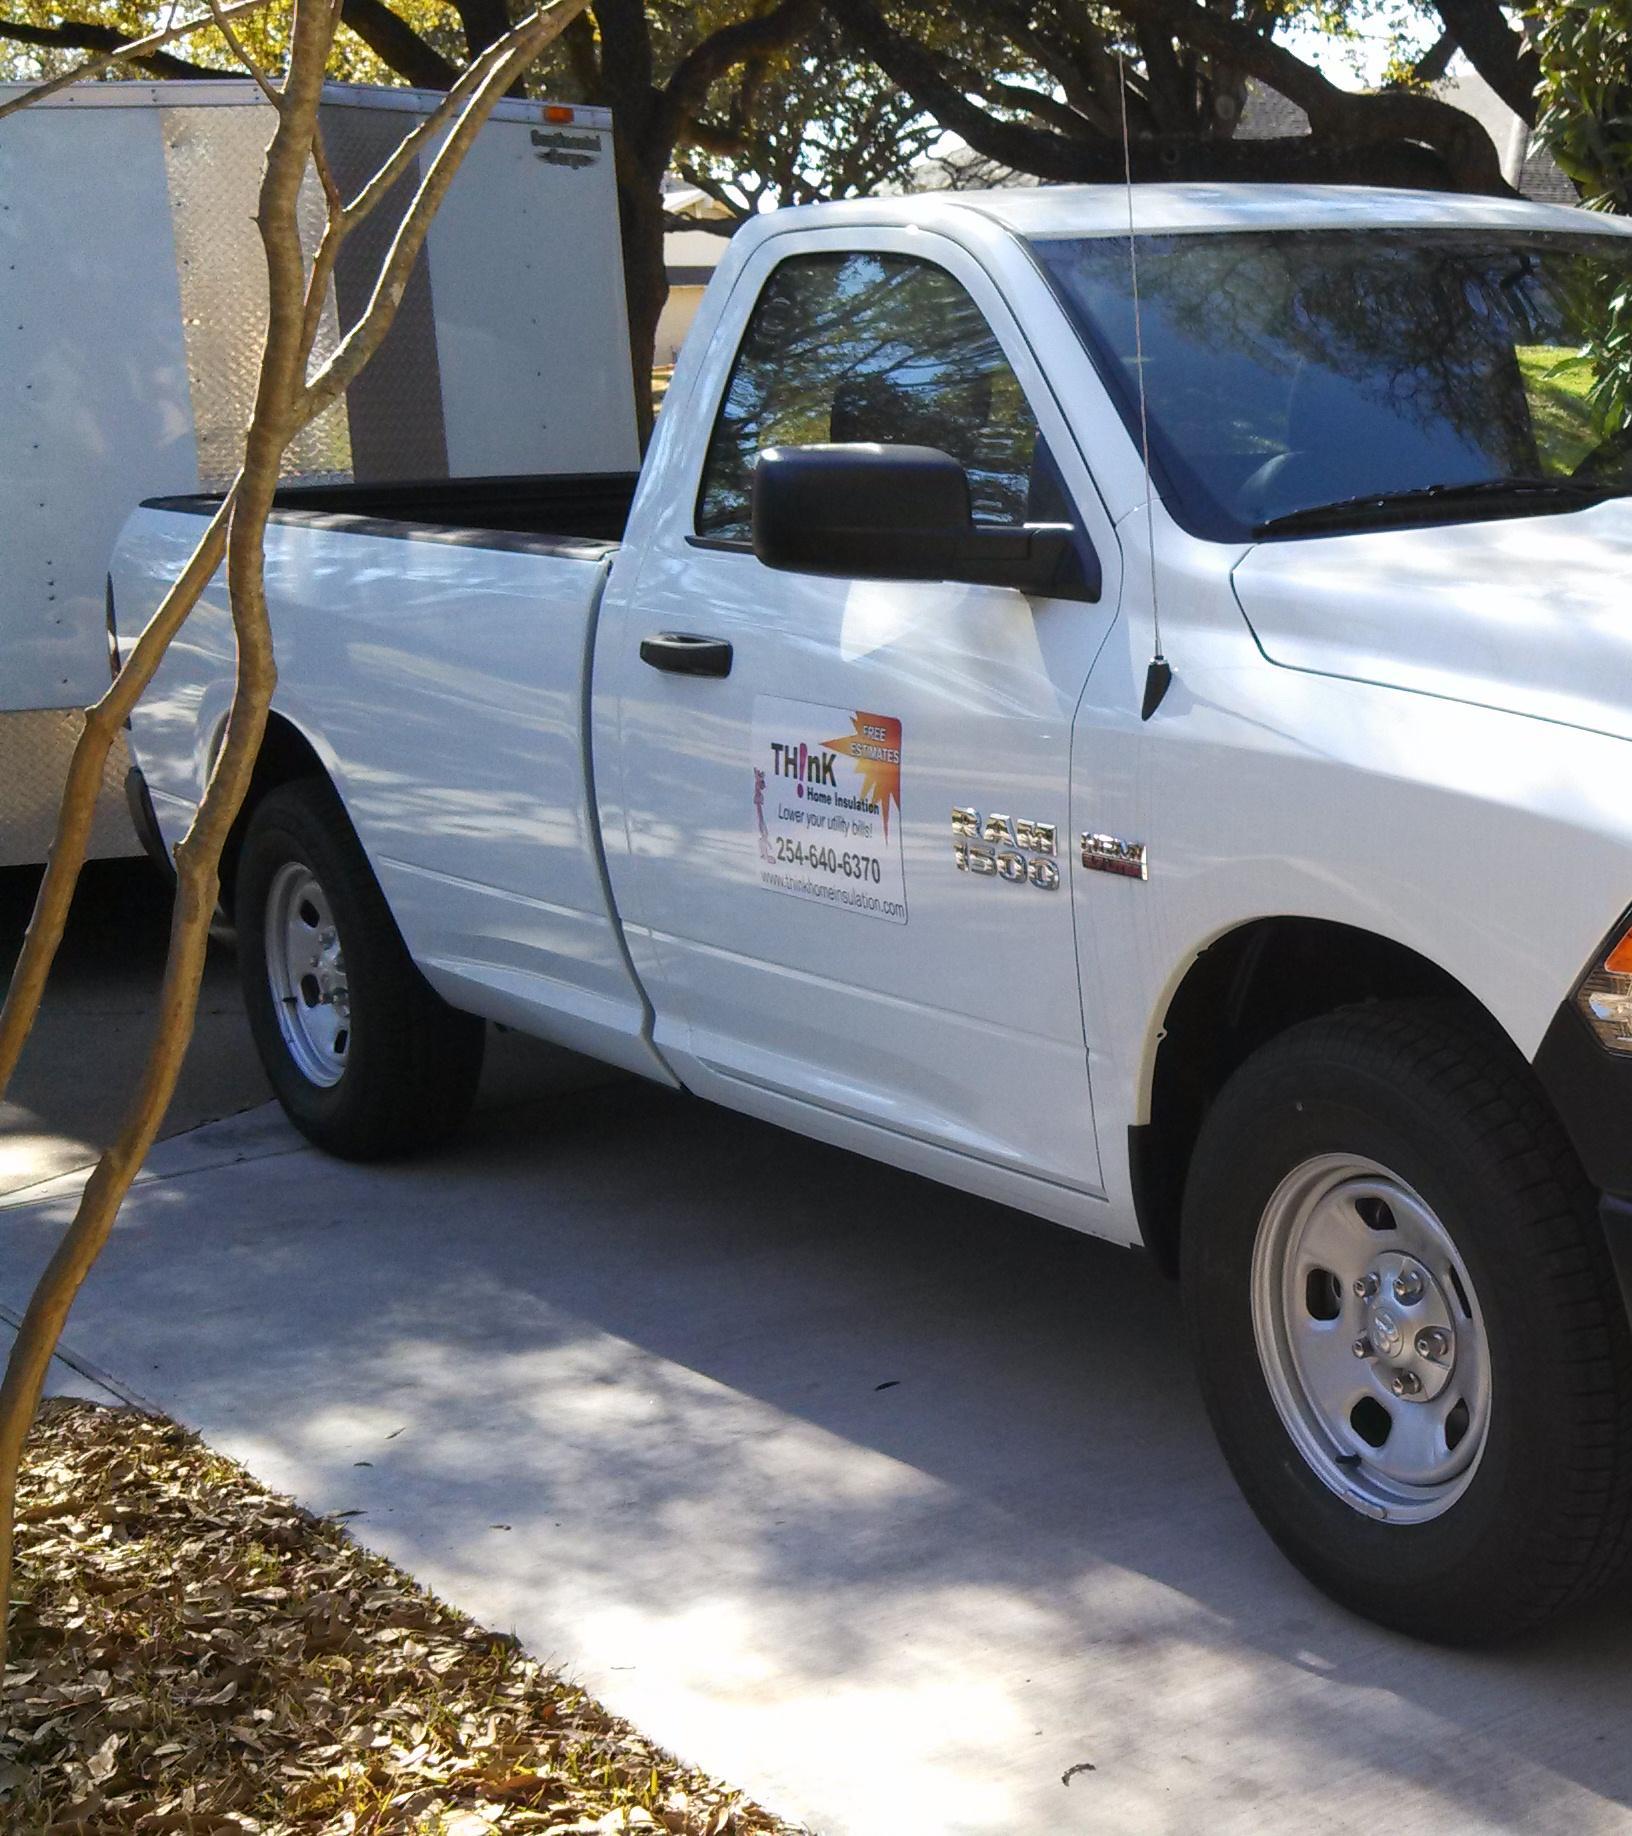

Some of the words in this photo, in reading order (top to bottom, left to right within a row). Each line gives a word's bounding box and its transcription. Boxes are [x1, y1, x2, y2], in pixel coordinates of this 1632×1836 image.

[850, 743, 900, 764] ESTIMATES
[863, 725, 886, 742] FREE
[778, 803, 805, 821] Lower
[806, 812, 826, 830] your
[827, 815, 850, 838] utility
[852, 818, 873, 839] bills!
[806, 786, 832, 805] Home
[834, 792, 880, 815] Insulation
[951, 806, 1058, 857] RAM
[776, 836, 881, 884] 254-640-6370
[953, 839, 1060, 891] 1500
[761, 870, 906, 918] www.thinkhomeinsulation.com
